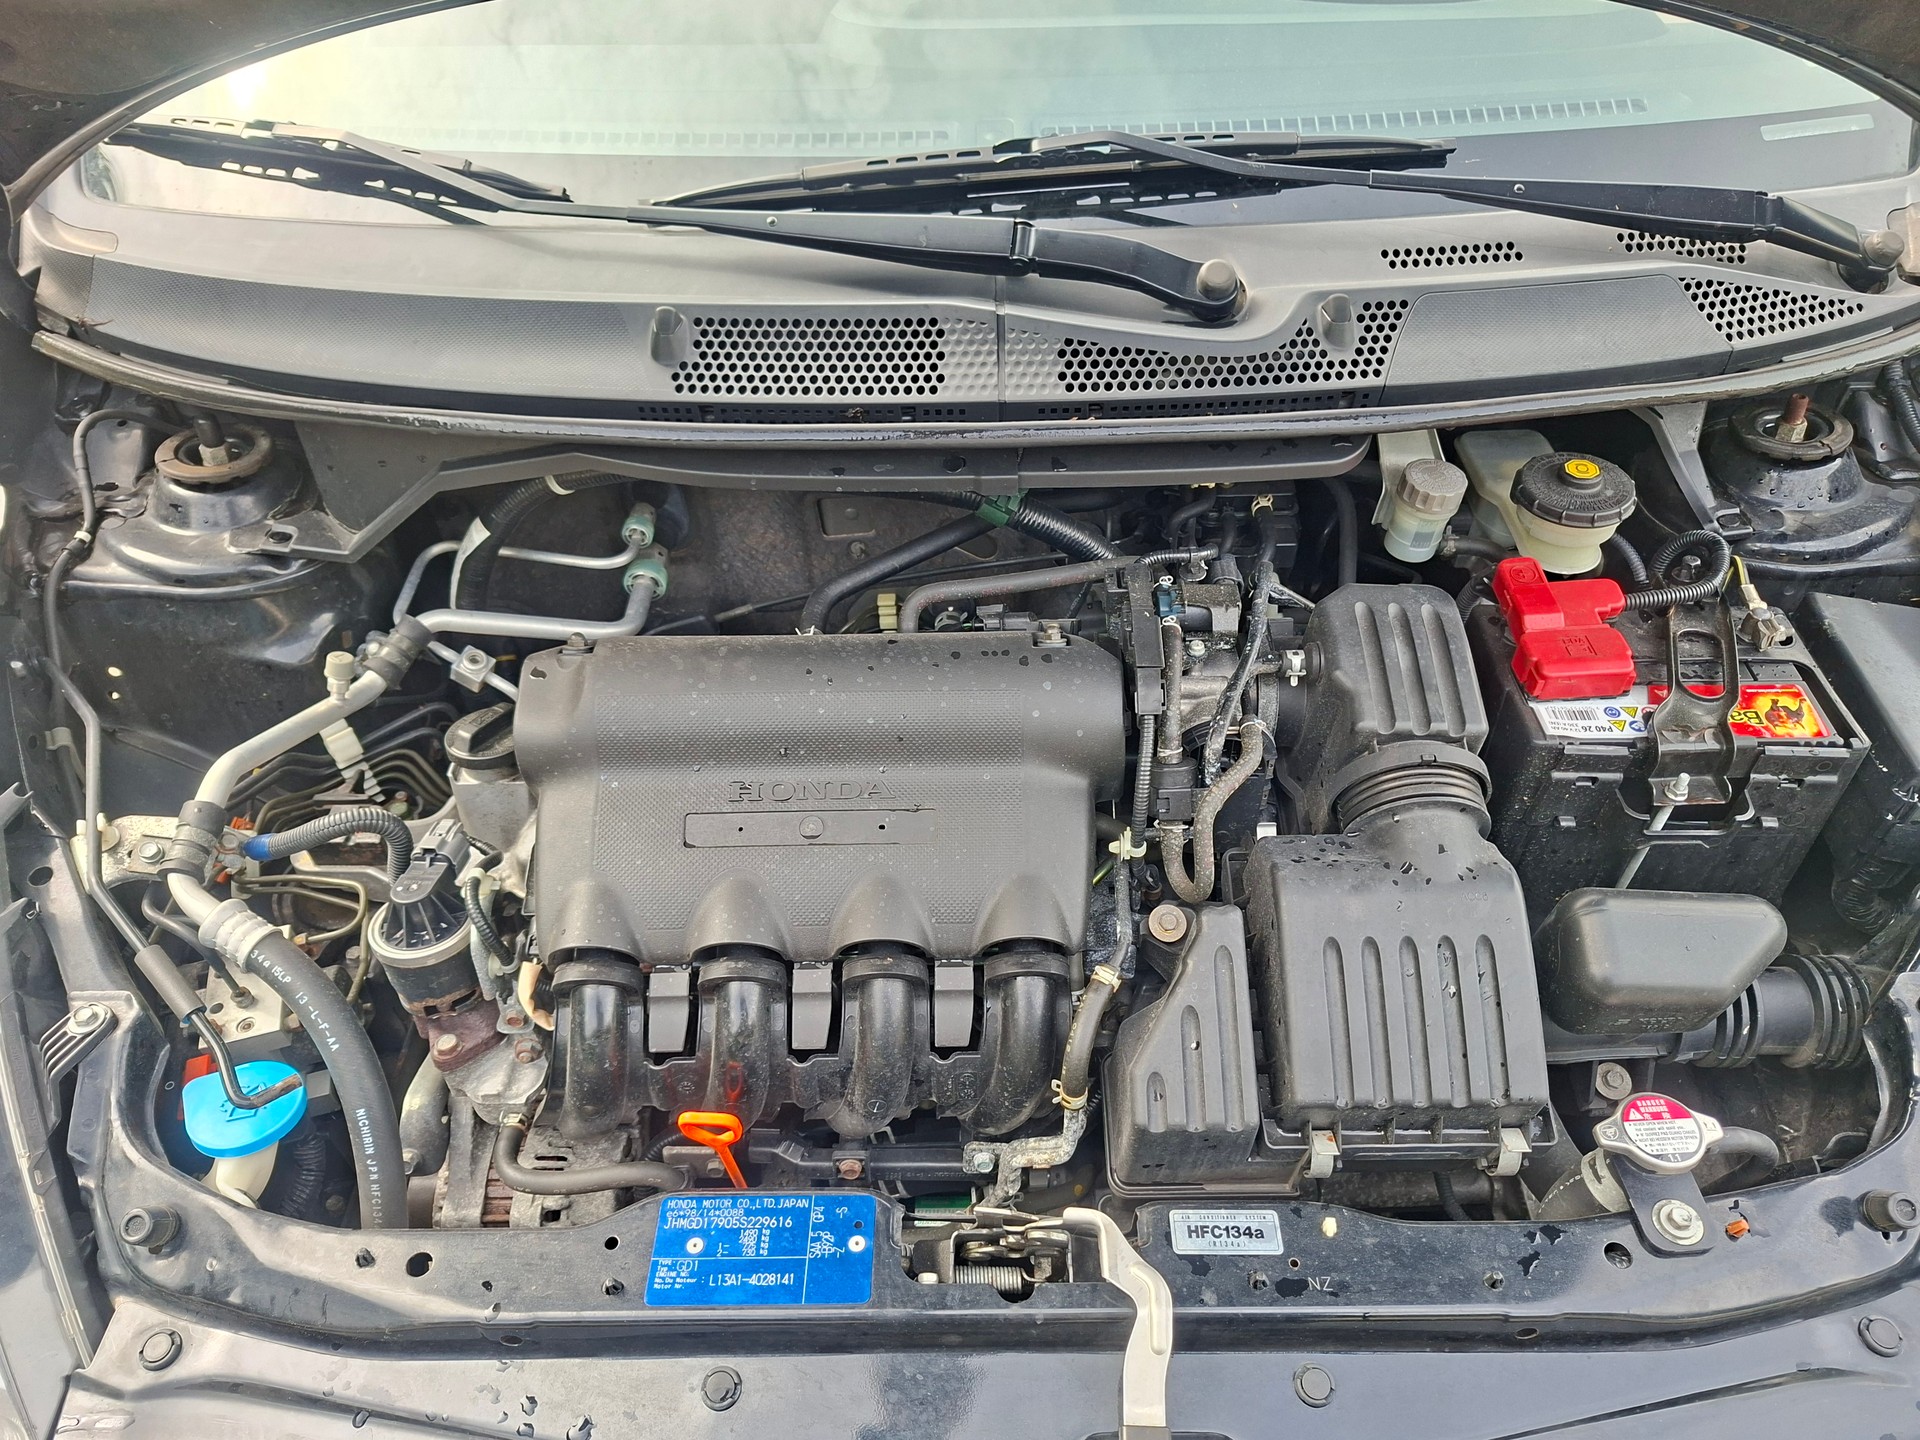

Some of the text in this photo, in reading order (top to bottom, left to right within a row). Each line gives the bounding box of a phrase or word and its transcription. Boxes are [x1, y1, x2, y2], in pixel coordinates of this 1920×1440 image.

[1728, 710, 1764, 725] Ba
[1595, 725, 1614, 733] P40
[728, 779, 896, 803] HONDA
[355, 1108, 374, 1155] NICHIRIN
[366, 1159, 378, 1181] JPN
[1668, 1153, 1681, 1162] 1.1
[667, 1200, 697, 1209] HONDA
[702, 1199, 732, 1208] MOTOR
[663, 1216, 793, 1229] JHMGD17905S229616
[1186, 1224, 1265, 1239] HFC134a
[676, 1260, 698, 1272] GD1
[1307, 1276, 1334, 1291] NZ
